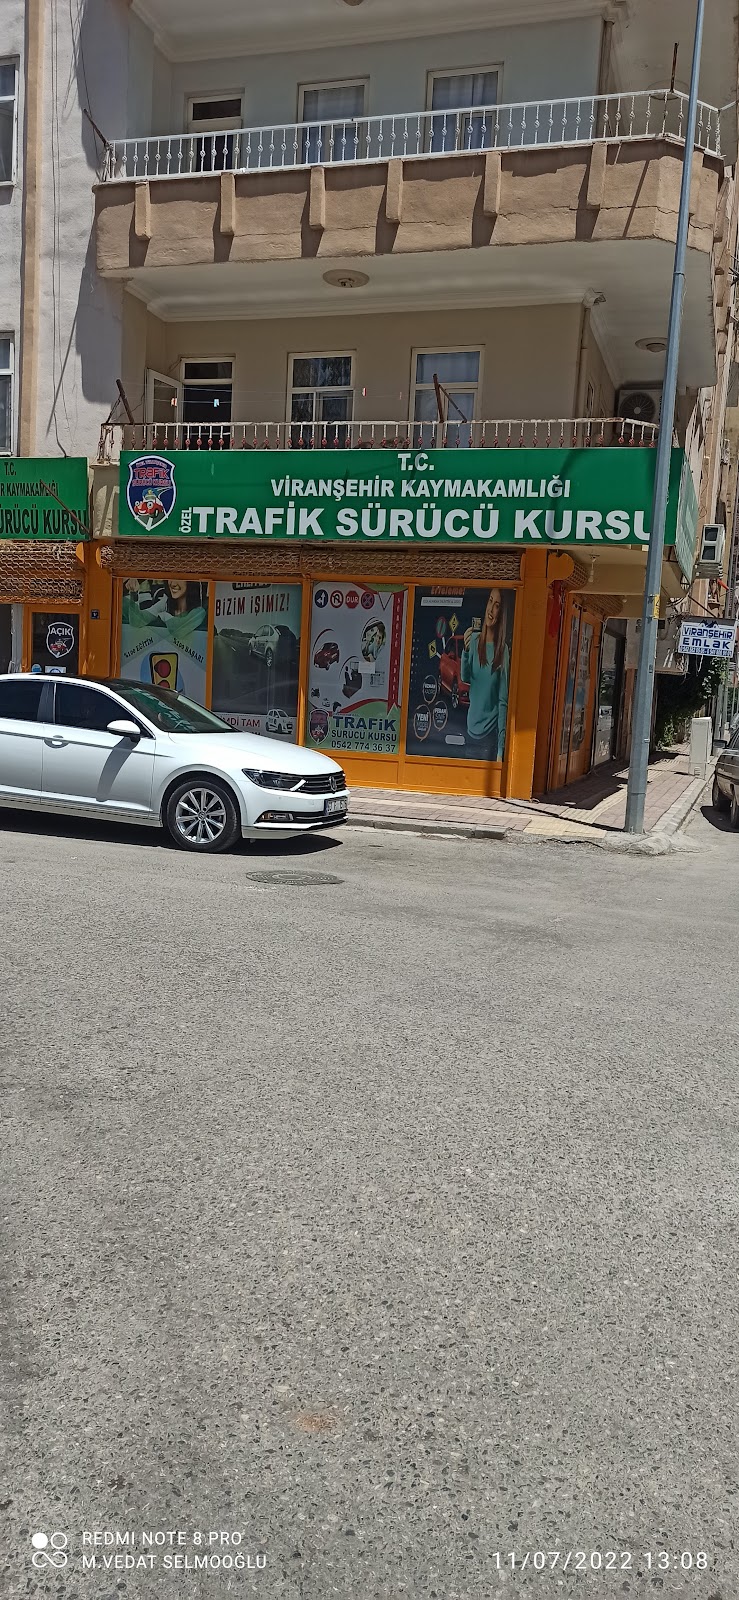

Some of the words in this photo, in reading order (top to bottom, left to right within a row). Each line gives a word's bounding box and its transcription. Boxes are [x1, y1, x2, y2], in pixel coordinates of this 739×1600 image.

[4, 462, 17, 476] T.C.
[398, 452, 435, 471] T.C.
[271, 475, 394, 501] VİRANŞEHİR
[401, 475, 571, 498] KAYMAKAMLIĞI
[43, 509, 88, 536] KURSU
[178, 506, 192, 533] ÖZEL
[193, 501, 324, 536] TRAFİK
[335, 503, 499, 537] SÜRÜCÜ
[50, 627, 71, 636] AÇIK
[241, 718, 260, 728] TAM
[368, 732, 397, 742] KURSU
[331, 740, 352, 749] 0542
[355, 741, 370, 750] 774
[372, 743, 383, 752] 36
[385, 744, 396, 753] 37
